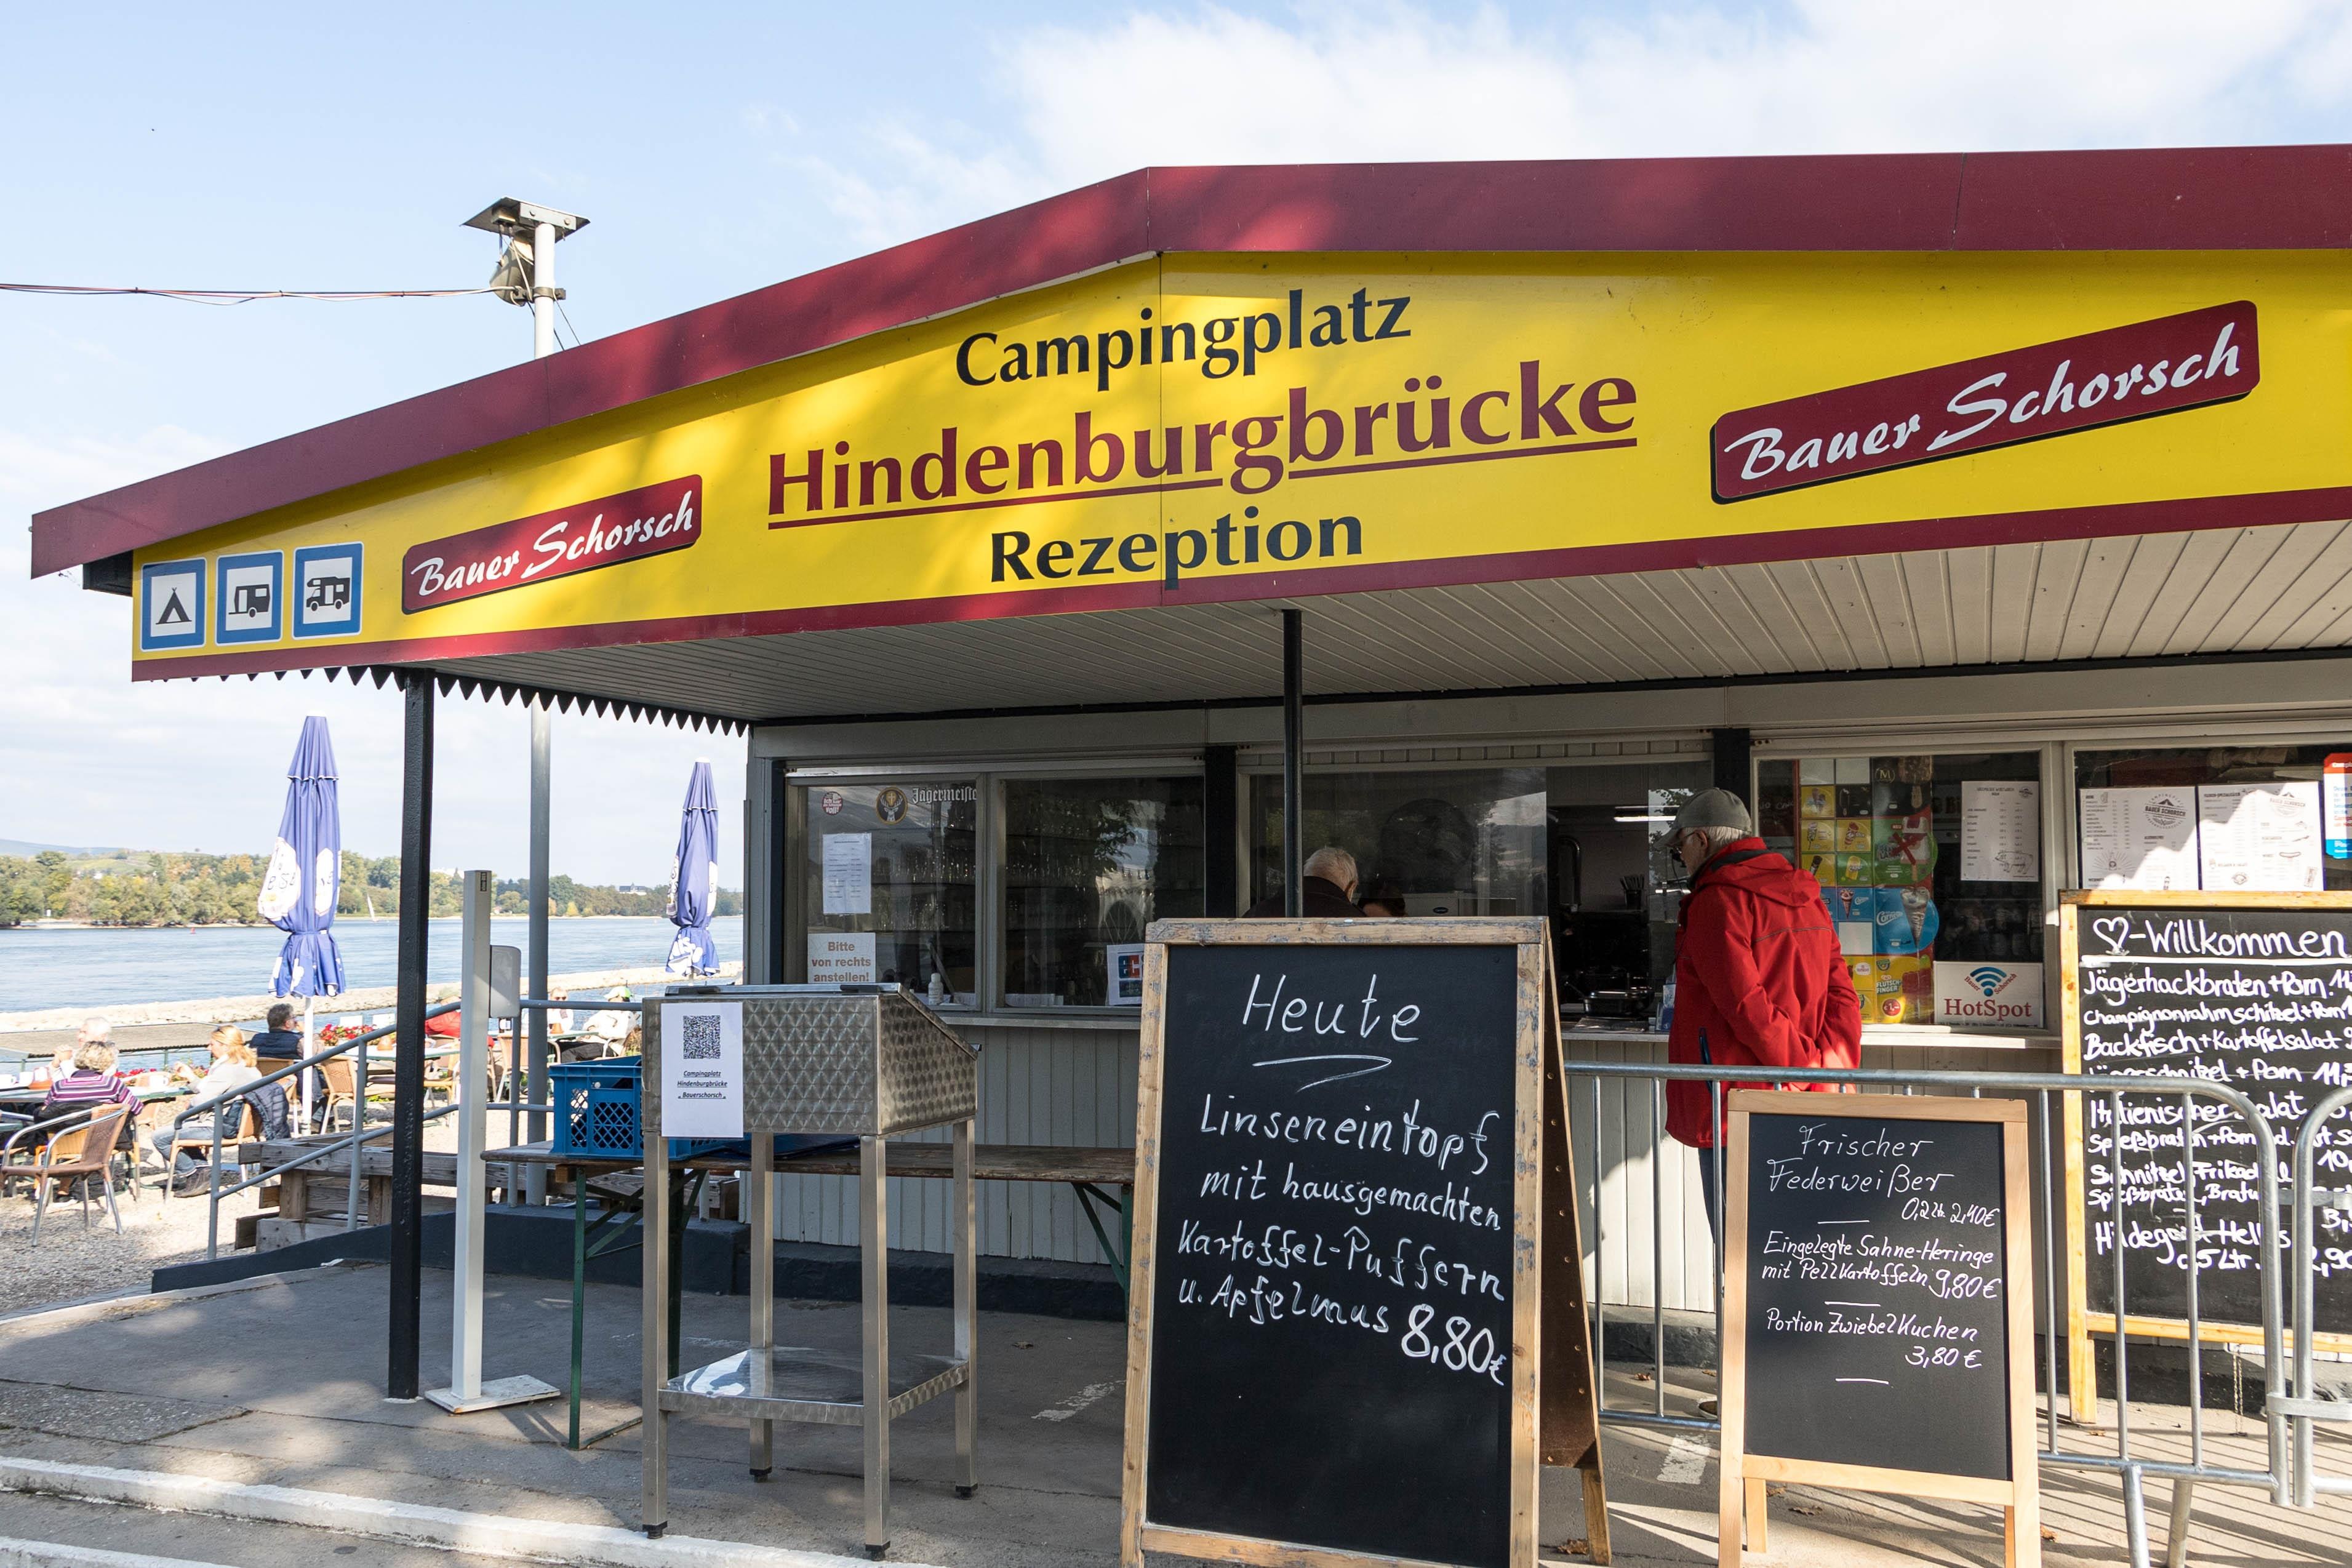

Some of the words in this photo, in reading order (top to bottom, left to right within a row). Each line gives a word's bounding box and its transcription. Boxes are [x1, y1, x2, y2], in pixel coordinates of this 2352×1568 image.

[956, 287, 1410, 391] Campingplatz
[1725, 414, 1921, 479] Bauer
[1927, 322, 2239, 450] Schorsch
[769, 360, 1637, 515] Hindenburgbrücke
[411, 550, 519, 596] Bauer
[521, 490, 692, 579] Schorsch
[991, 506, 1361, 590] Rezeption
[912, 786, 977, 804] Jägermeiste
[828, 942, 855, 951] Bitte
[835, 957, 871, 966] rechts
[813, 972, 869, 983] anstellen!
[1877, 985, 1898, 994] FINGER
[1964, 976, 1980, 991] Bauer
[1994, 973, 2018, 994] Schorsch
[1243, 974, 1420, 1042] Heute
[1944, 999, 2032, 1021] HotSpot
[1201, 1094, 1500, 1174] Linseneintopf
[1799, 1124, 1934, 1158] Frischer
[1201, 1160, 1266, 1200] mit
[1282, 1162, 1501, 1231] hausgemachten
[1767, 1158, 1954, 1198] Federweißer
[1762, 1231, 1852, 1260] Eingelegte
[1857, 1234, 1994, 1270] Sahne-Heringe
[1762, 1260, 1790, 1279] mit
[1210, 1274, 1389, 1333] Apfelmus
[1766, 1307, 1823, 1331] Portion
